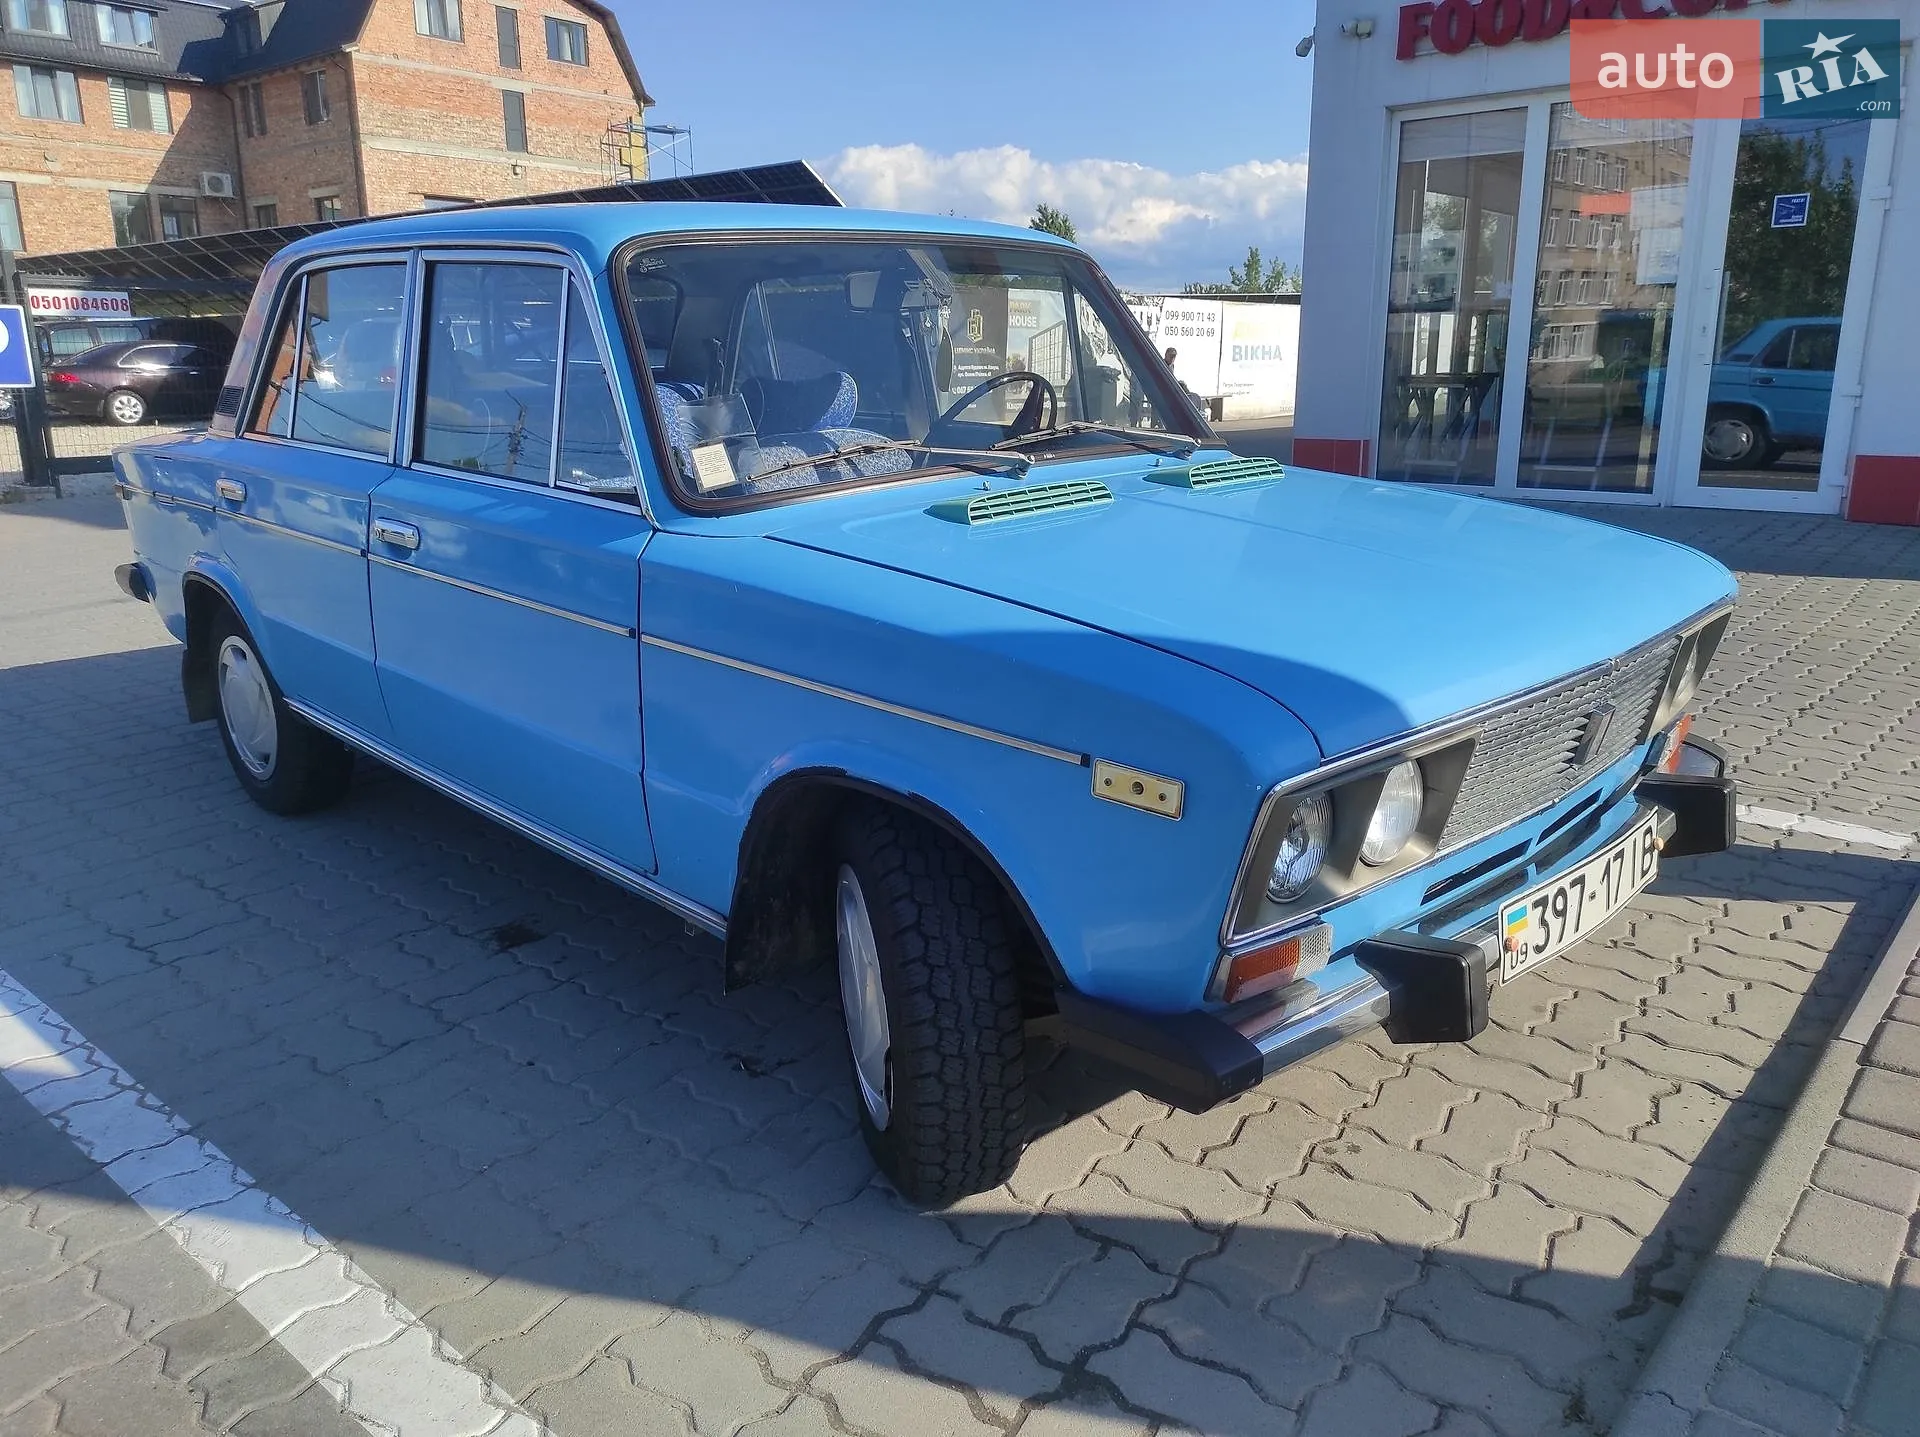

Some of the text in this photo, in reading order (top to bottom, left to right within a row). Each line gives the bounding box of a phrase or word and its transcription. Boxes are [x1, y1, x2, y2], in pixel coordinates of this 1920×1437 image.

[30, 295, 129, 312] 0501084608
[1009, 315, 1037, 328] HOUSE
[1165, 310, 1180, 321] 099
[1181, 311, 1195, 322] 900
[1196, 312, 1205, 323] 71
[1206, 312, 1216, 323] 43
[1164, 326, 1215, 338] 050 560 20 69
[1231, 344, 1283, 362] ВІКНА
